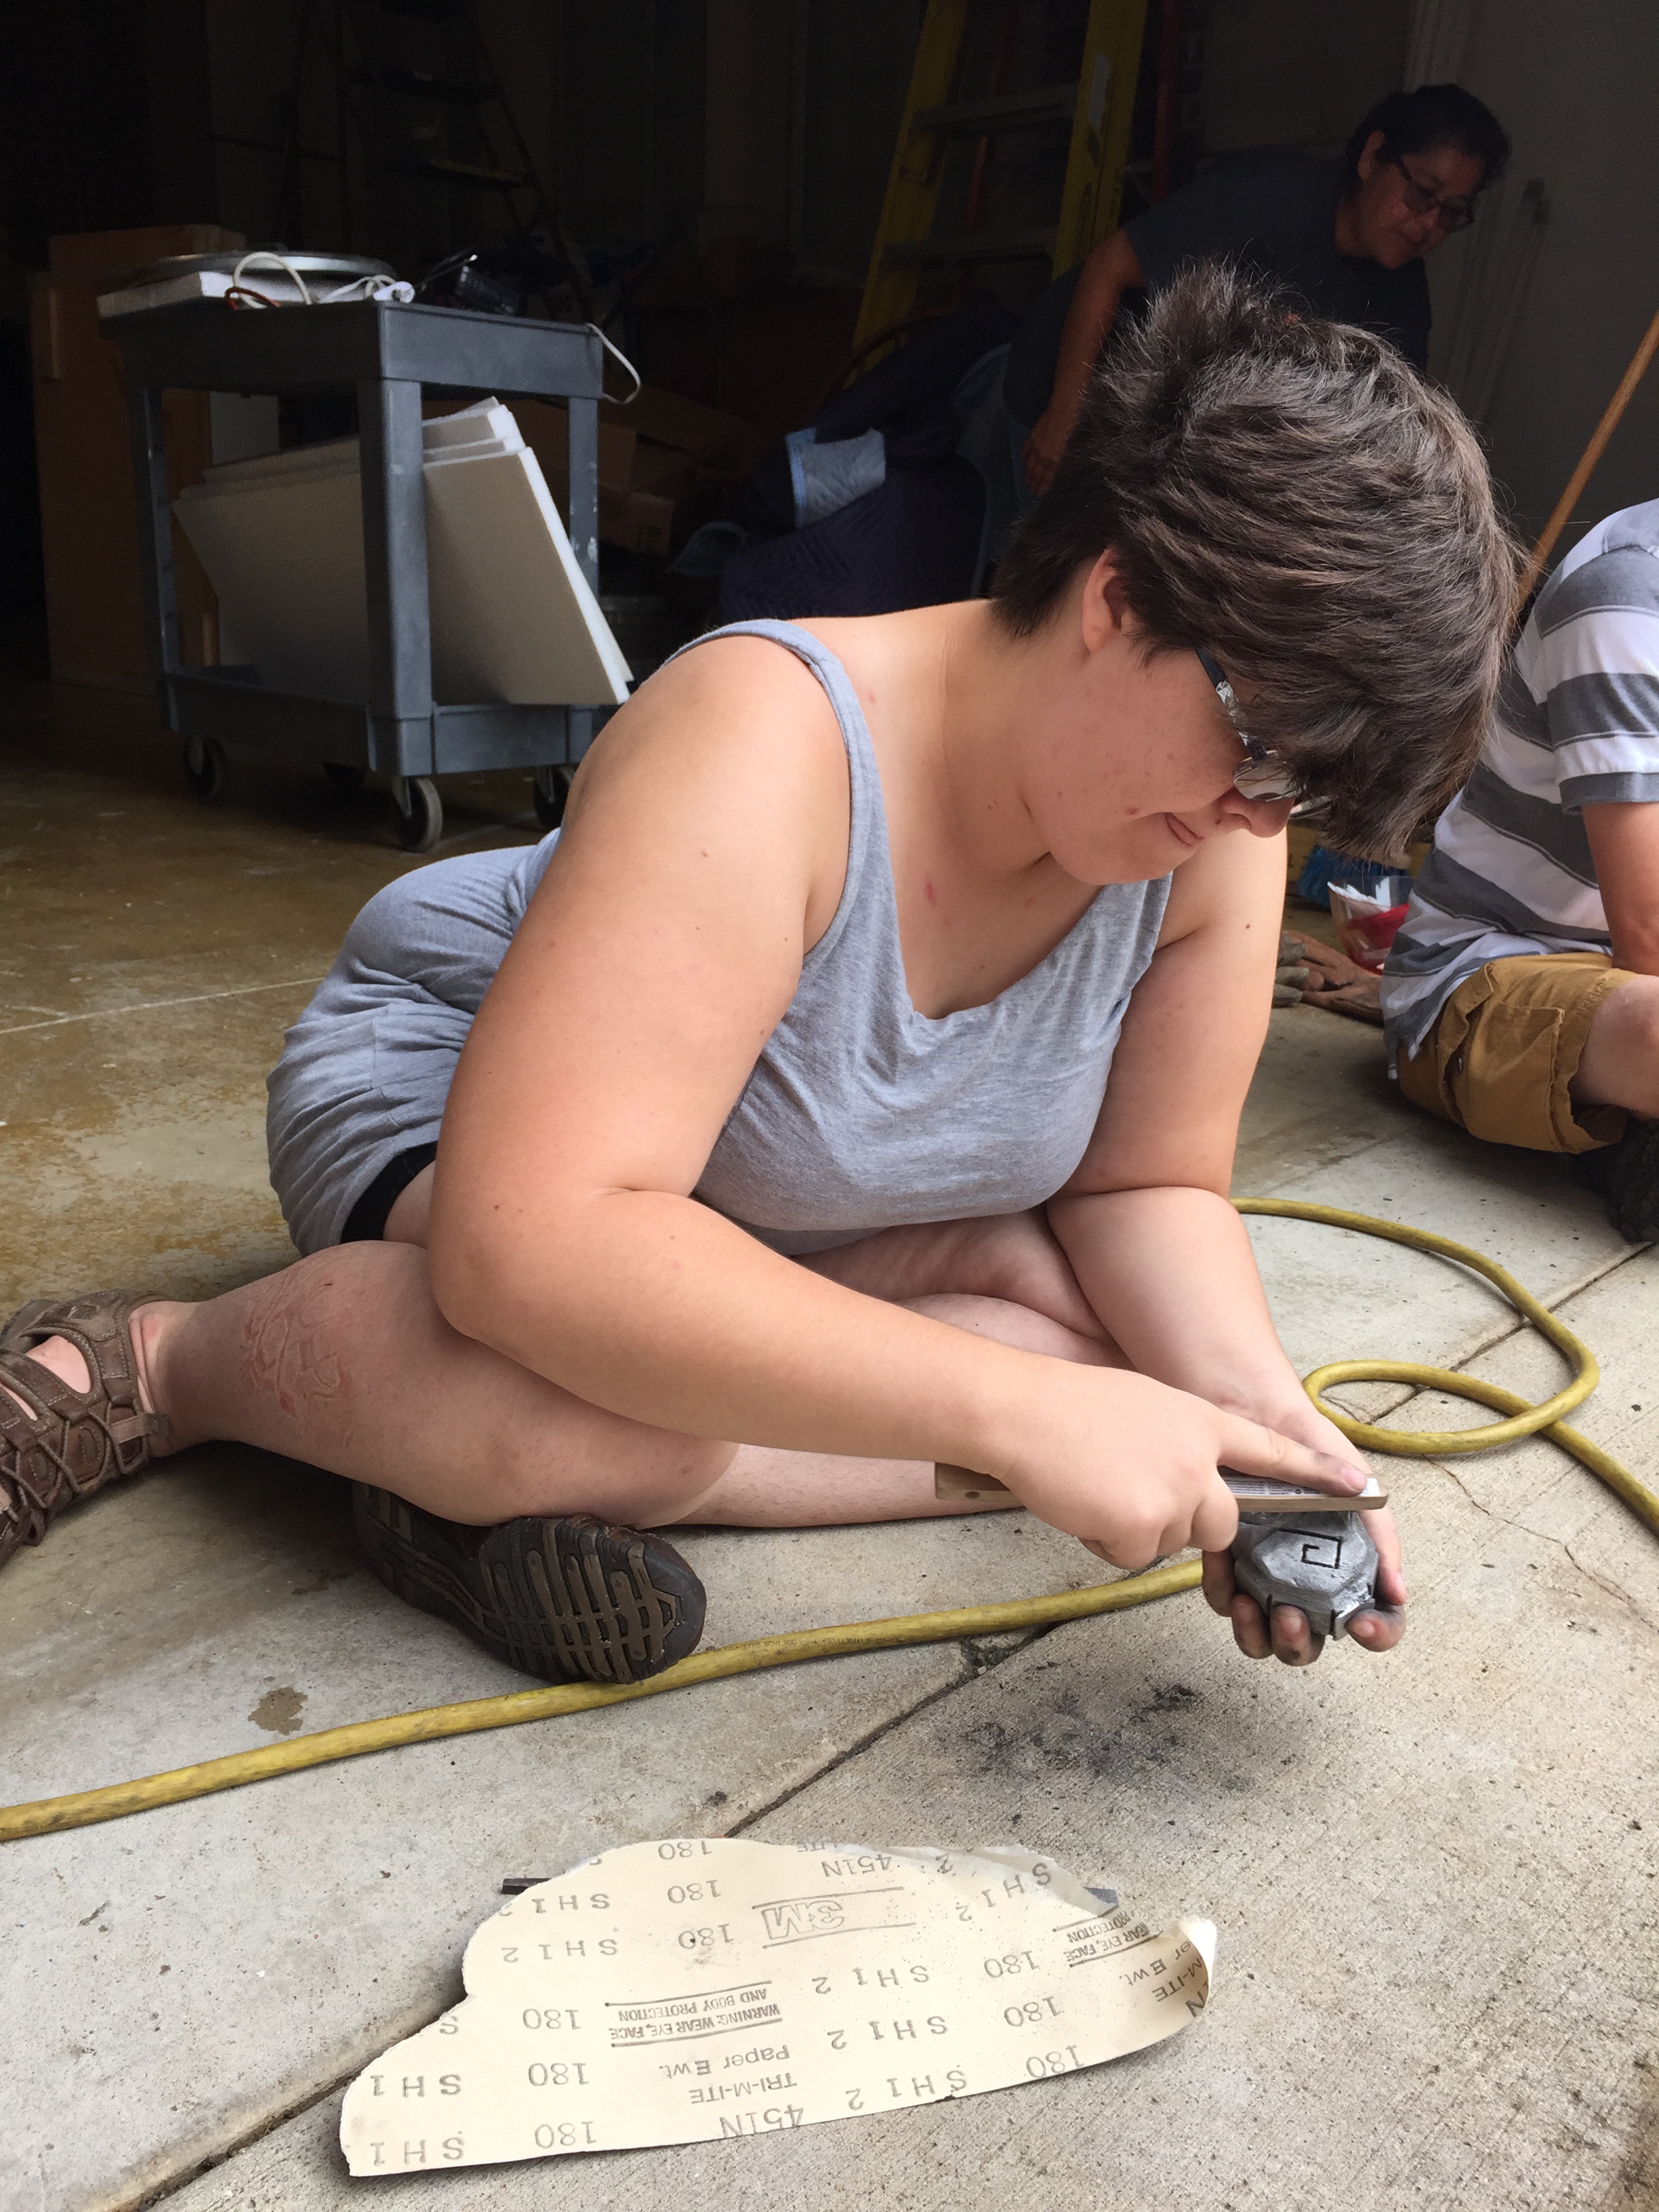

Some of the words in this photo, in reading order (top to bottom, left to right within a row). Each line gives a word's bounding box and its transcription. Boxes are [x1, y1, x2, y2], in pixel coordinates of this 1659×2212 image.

[658, 1841, 712, 1860] 180
[668, 1880, 721, 1904] 180
[761, 1900, 844, 1940] 3M
[1066, 1911, 1131, 1944] PROTECTION
[678, 1923, 733, 1949] 180
[1096, 1936, 1122, 1951] EYE,
[984, 1950, 1040, 1978] 180
[1063, 1944, 1097, 1962] FACE
[703, 1995, 735, 2011] BODY
[739, 1988, 767, 2004] AND
[523, 2009, 581, 2030] 180
[618, 2002, 697, 2022] PROTECTION
[716, 2003, 780, 2026] WARNING:
[1004, 1996, 1061, 2027] 180
[608, 2026, 644, 2040] FACE
[645, 2024, 673, 2036] EYE,
[676, 2017, 715, 2033] WEAR
[723, 2045, 790, 2069] Paper
[1025, 2045, 1084, 2078] 180
[528, 2063, 589, 2087] 180
[535, 2121, 597, 2149] 180
